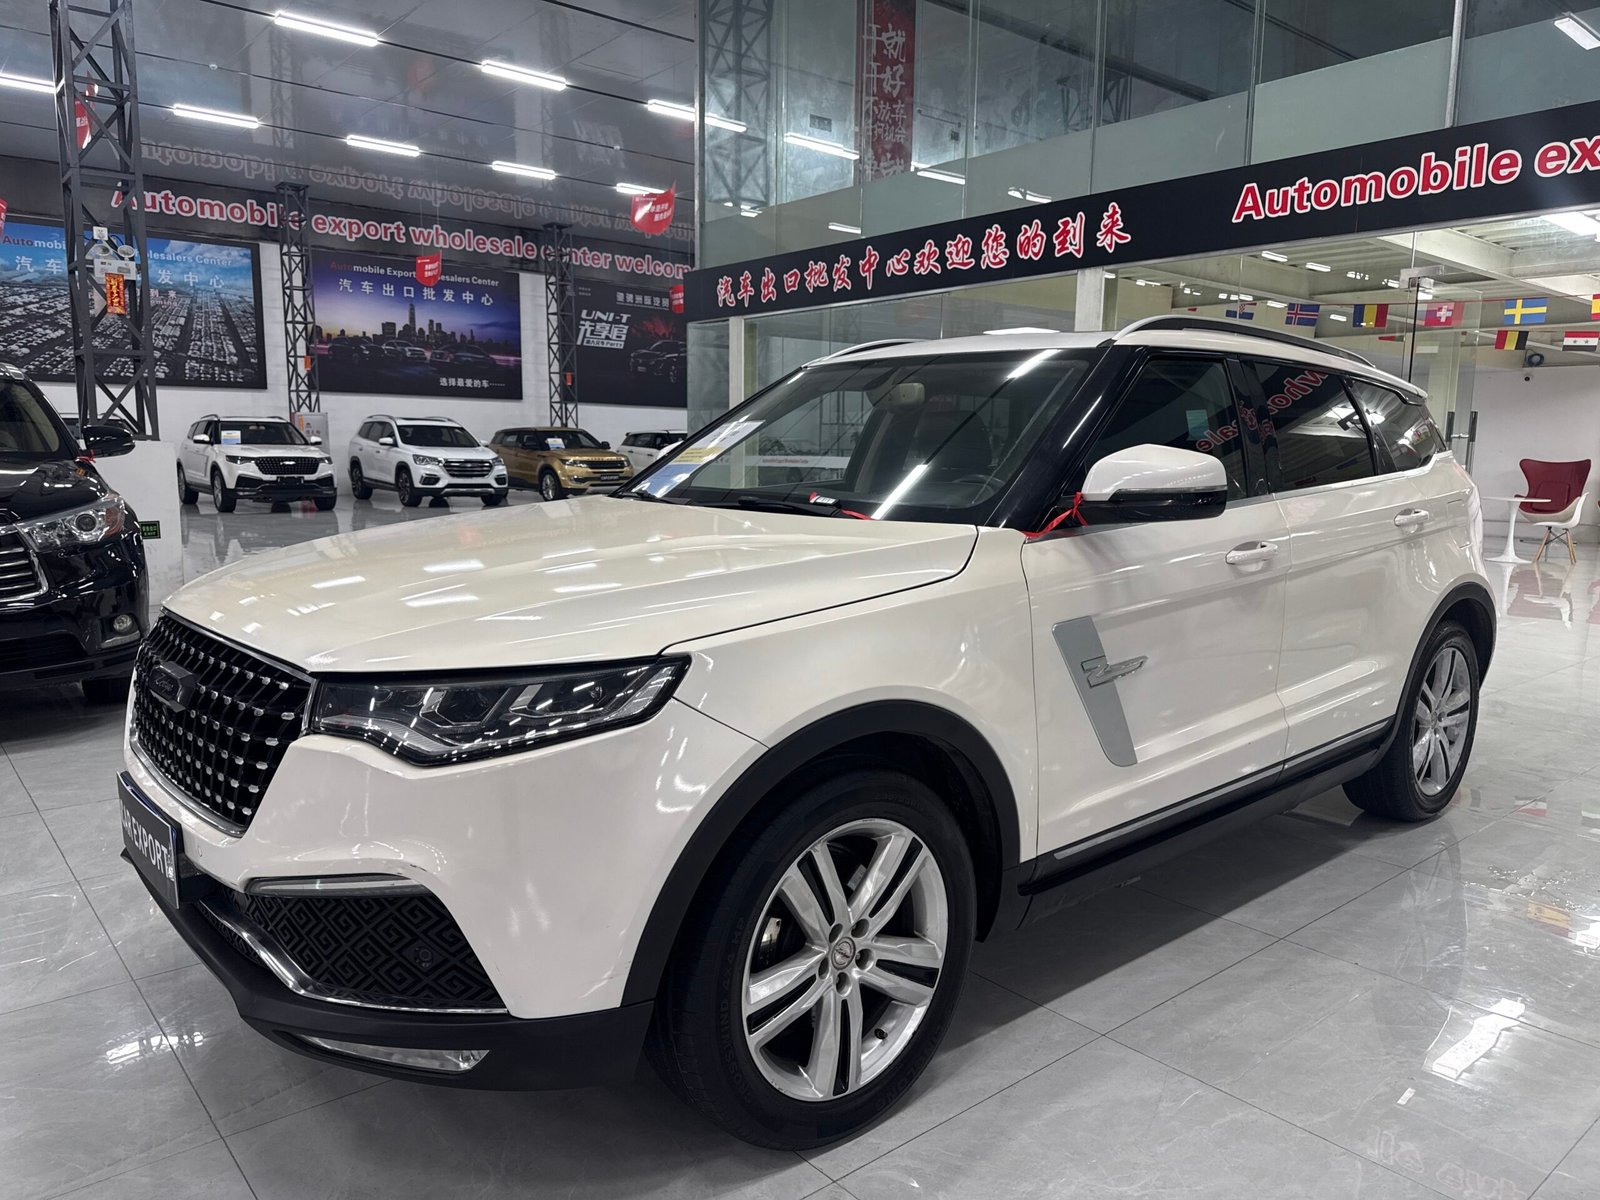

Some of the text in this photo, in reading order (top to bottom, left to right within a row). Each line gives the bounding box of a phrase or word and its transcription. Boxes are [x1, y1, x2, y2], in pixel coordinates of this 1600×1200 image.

[1232, 136, 1600, 223] Automobile ex
[2, 236, 67, 250] Automobi
[195, 254, 232, 267] Center
[311, 213, 405, 244] export
[411, 225, 537, 260] wholesale
[615, 254, 697, 280] welcom
[717, 202, 1132, 307] 汽车出口批发中心欢迎您的到来
[330, 262, 385, 275] Automobile
[387, 268, 416, 280] Export
[472, 277, 499, 287] Center
[339, 278, 494, 306] 汽车出口批发中心
[580, 309, 631, 323] UNI-T
[132, 816, 169, 879] EXPORT
